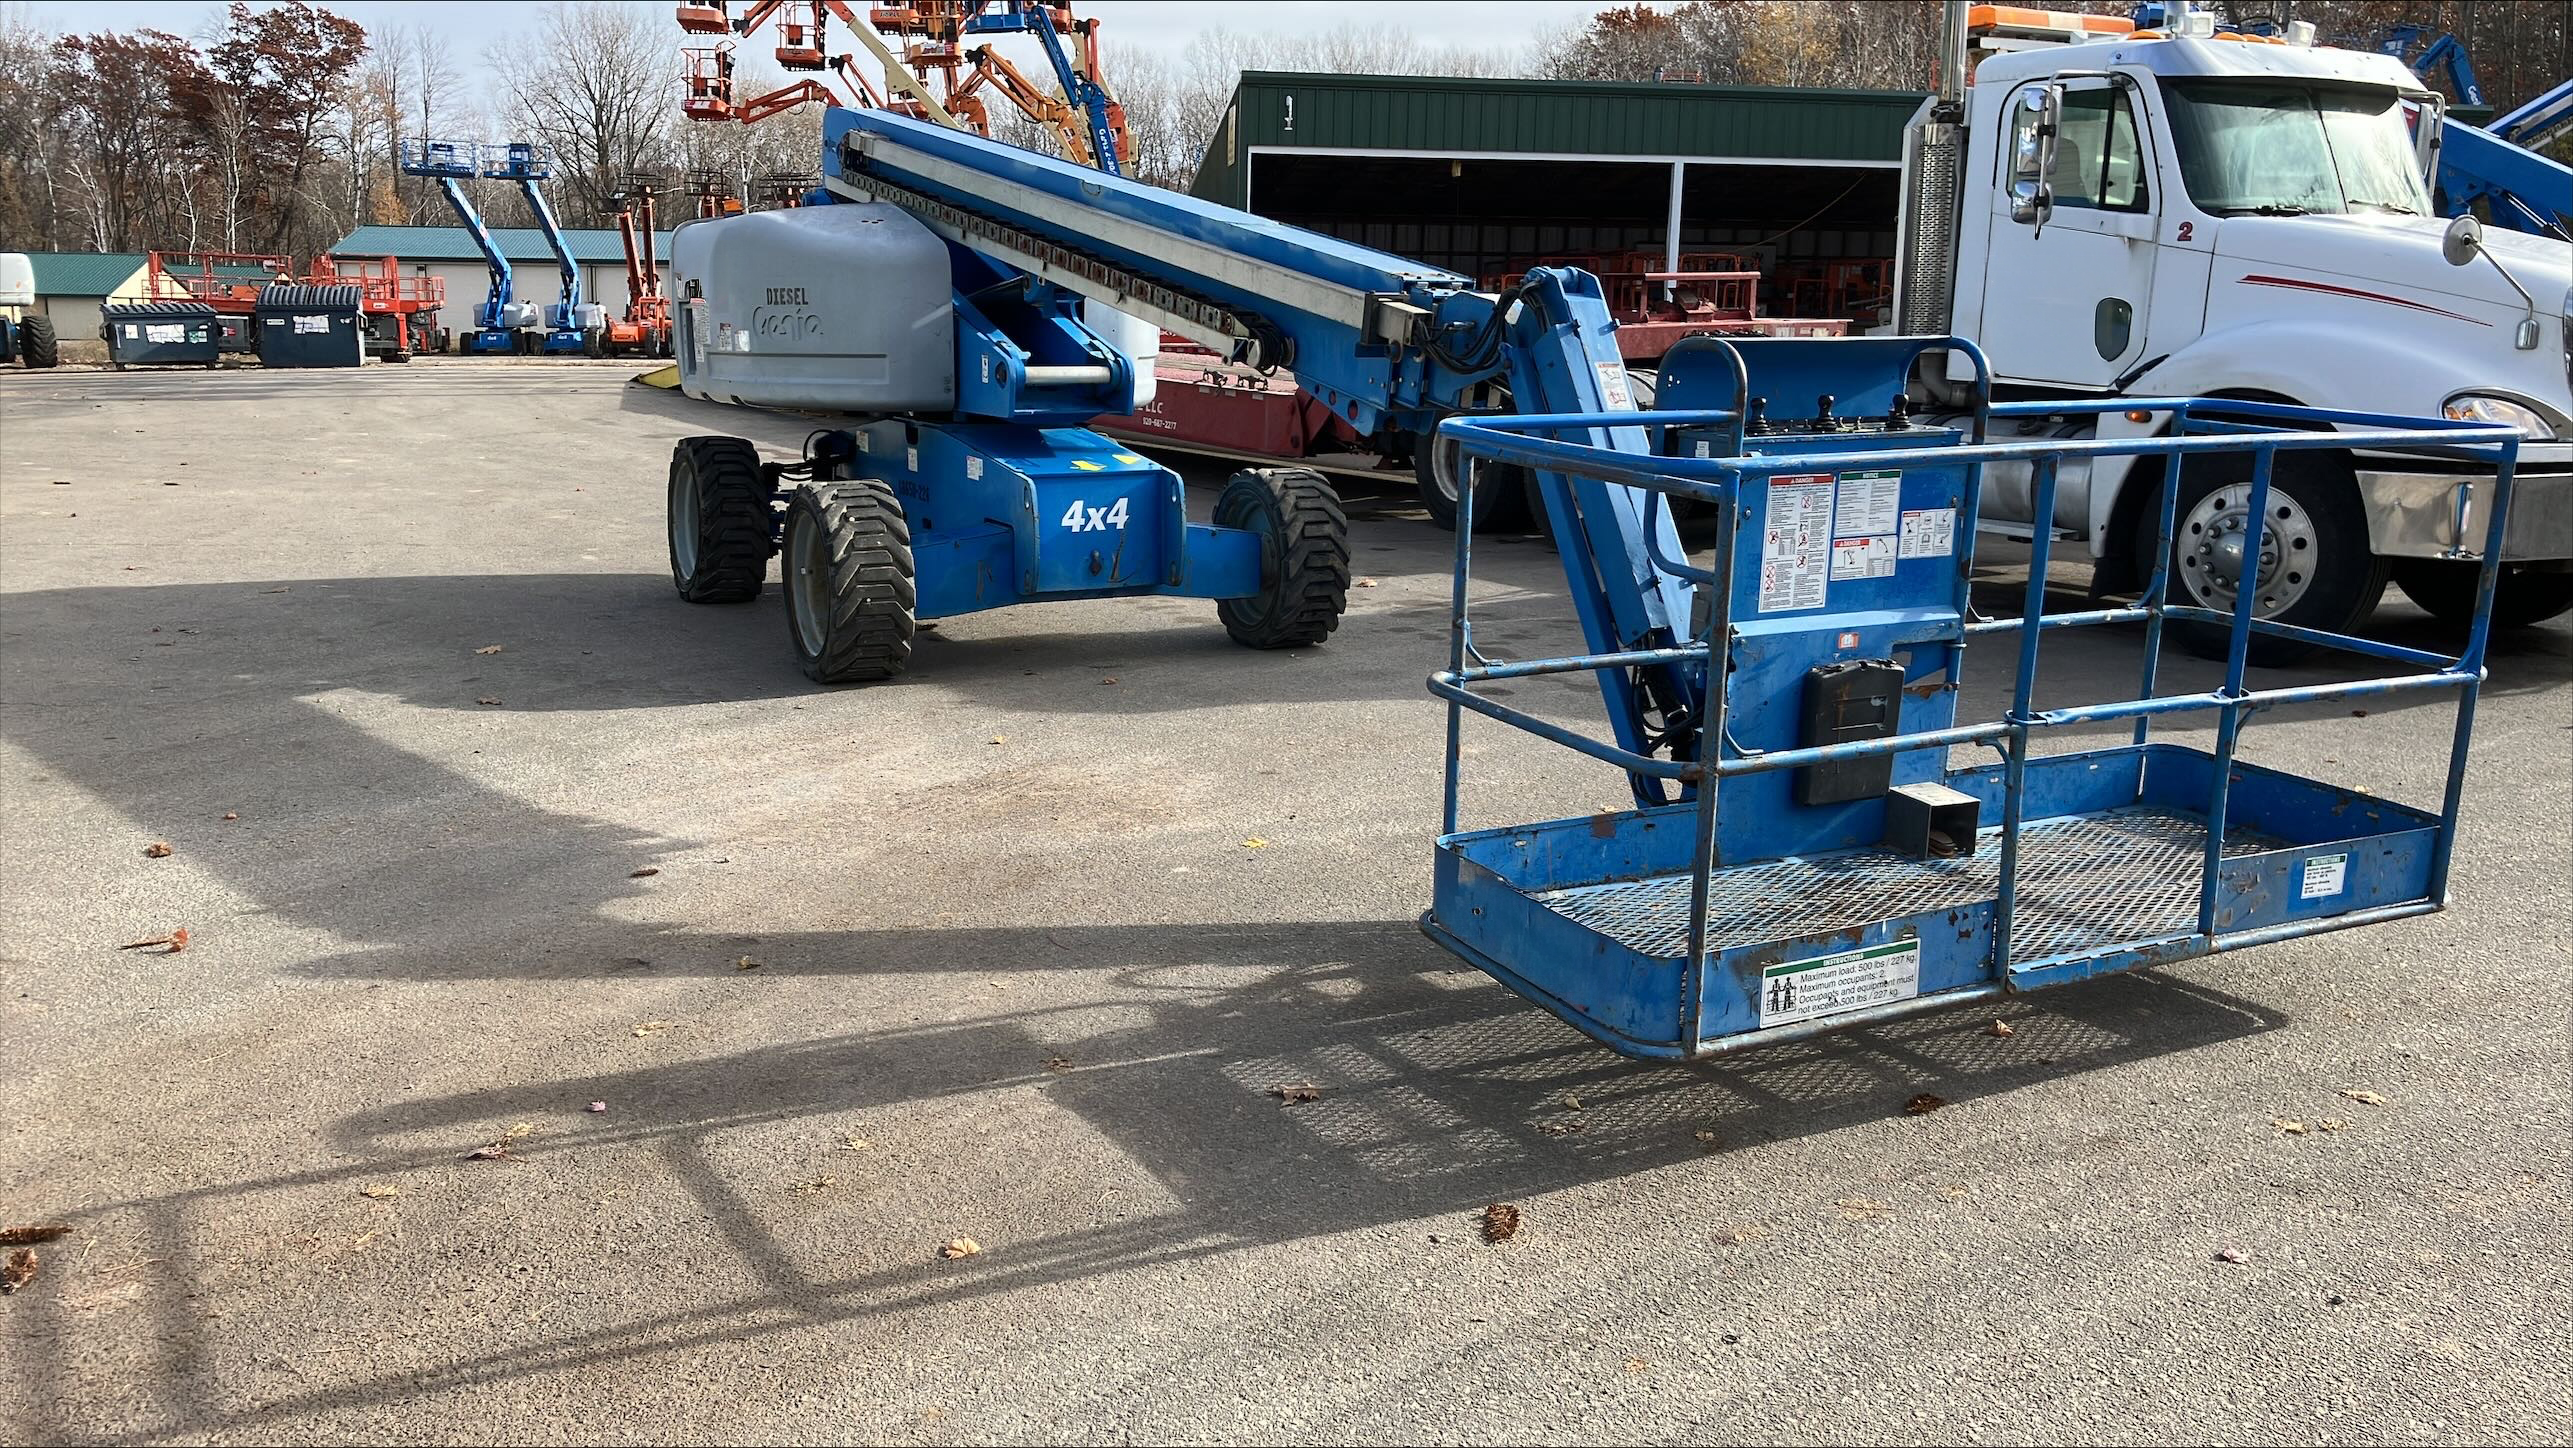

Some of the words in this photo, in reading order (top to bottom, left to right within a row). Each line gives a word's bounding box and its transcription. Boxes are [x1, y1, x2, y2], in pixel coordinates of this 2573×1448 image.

[2177, 221, 2193, 242] 2
[766, 287, 809, 306] DIESEL
[1061, 497, 1130, 533] 4x4
[1800, 970, 1837, 984] Maximum
[1838, 966, 1856, 977] load:
[1858, 962, 1873, 972] 500
[1874, 959, 1885, 969] lbs
[1890, 956, 1905, 966] 227
[1823, 952, 1865, 967] INSTRUCTIONS
[1799, 989, 1839, 1005] Occupants
[1841, 985, 1856, 996] and
[1856, 979, 1896, 995] equipment
[1896, 974, 1915, 985] must
[1800, 981, 1837, 994] Maximum
[1837, 971, 1878, 987] occupants:
[1797, 1004, 1811, 1015] not
[1812, 999, 1839, 1012] exceed
[1840, 996, 1855, 1006] 500
[1856, 992, 1868, 1003] lbs
[1873, 989, 1888, 1000] 227
